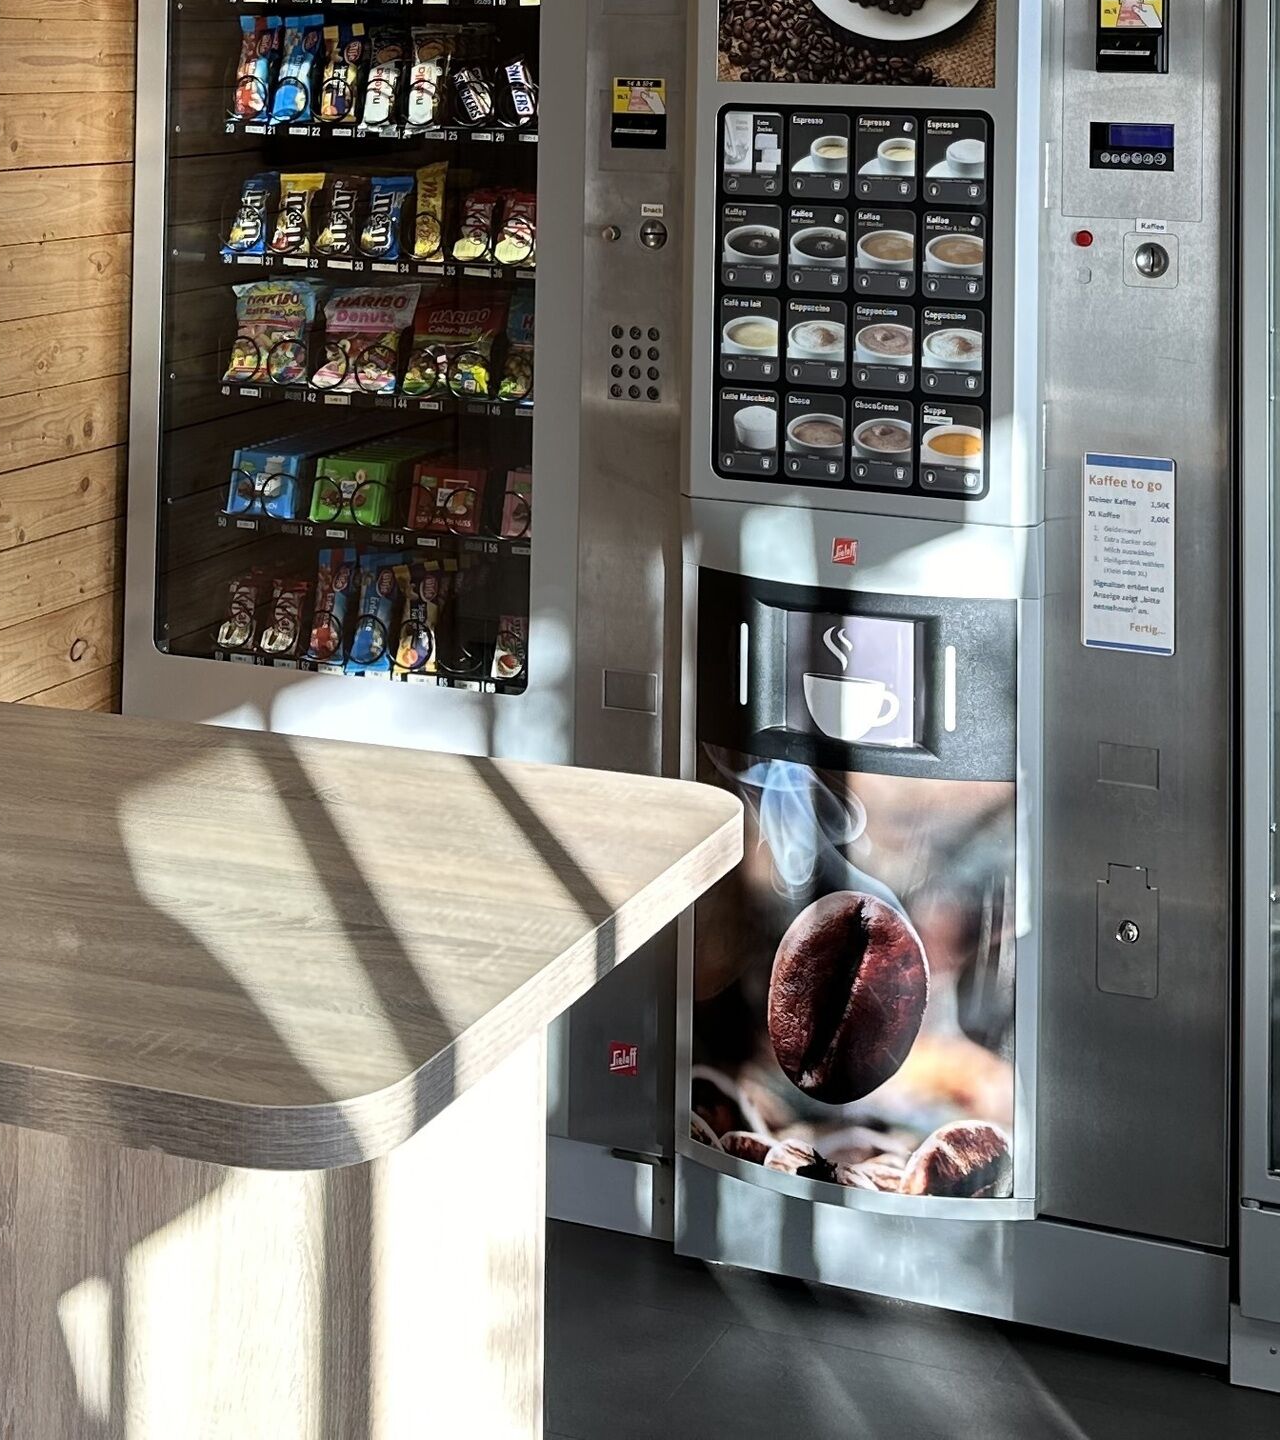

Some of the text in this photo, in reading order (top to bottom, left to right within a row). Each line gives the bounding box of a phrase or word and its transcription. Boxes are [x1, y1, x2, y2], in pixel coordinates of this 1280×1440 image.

[792, 116, 824, 126] Espresso
[858, 118, 891, 128] Espresso
[927, 120, 960, 130] Espresso
[335, 294, 408, 309] HARIBO
[790, 302, 831, 313] Cappuccino
[336, 309, 396, 324] Donuts
[857, 305, 898, 316] Cappuccino
[924, 310, 966, 321] Cappuccino
[429, 309, 491, 325] HARIBO
[1089, 474, 1162, 492] Kaffee to go
[1088, 495, 1170, 510] Kleiner Kaffee 1,50€
[1098, 511, 1120, 519] Kaffee
[1151, 516, 1170, 524] 2,00€
